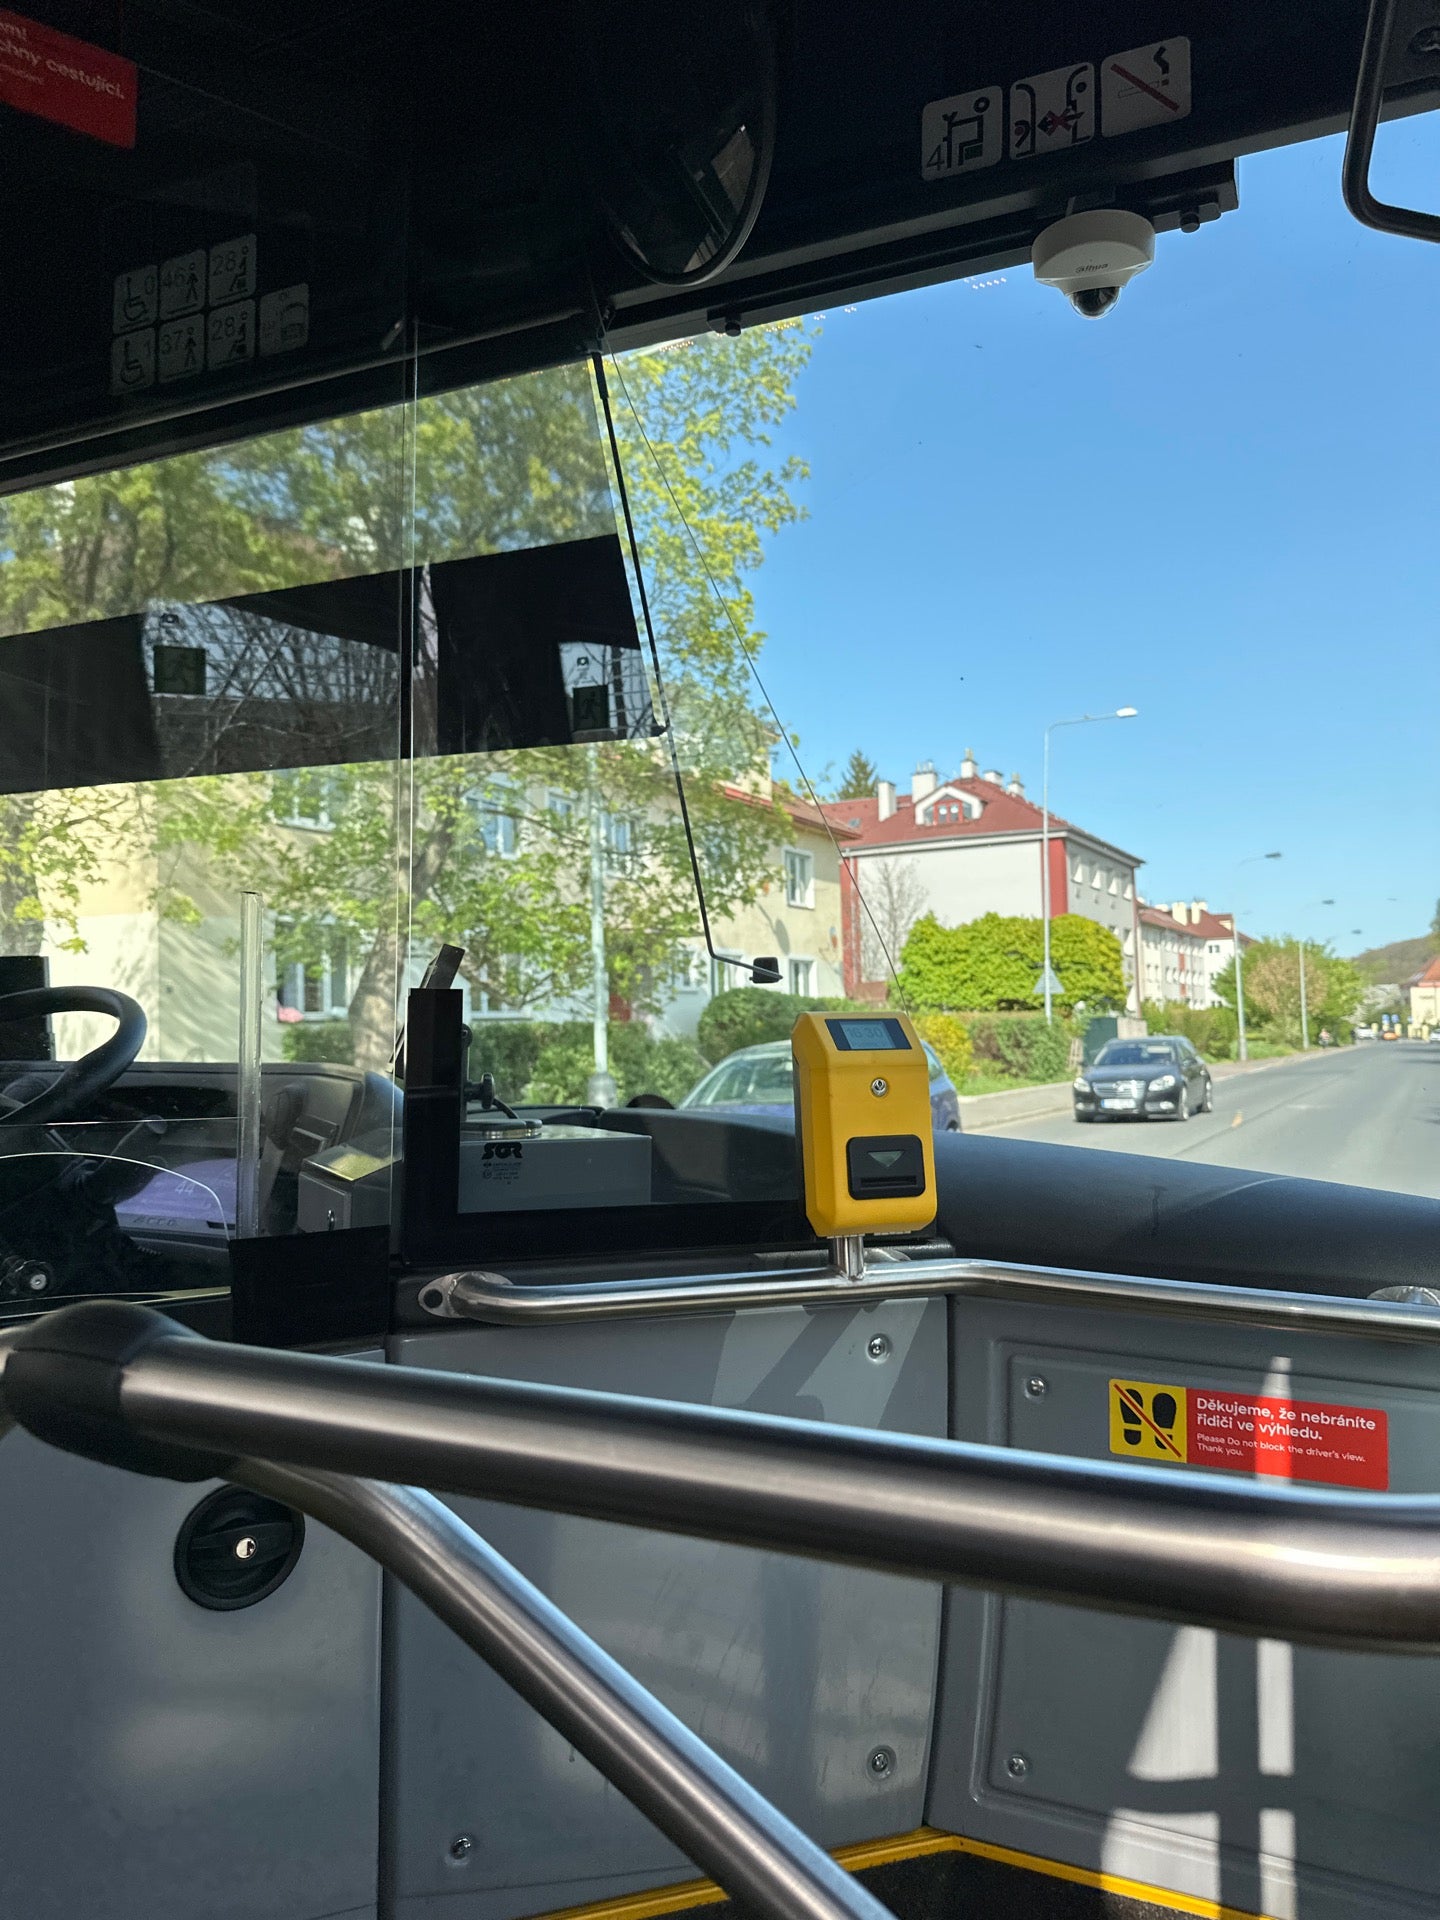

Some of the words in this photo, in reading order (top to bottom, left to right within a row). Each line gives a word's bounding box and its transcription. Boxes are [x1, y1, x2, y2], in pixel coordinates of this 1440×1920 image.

[926, 144, 944, 171] 4
[211, 250, 236, 276] 28
[211, 316, 236, 342] 28
[482, 1142, 523, 1160] SOR
[1197, 1397, 1275, 1420] Děkujeme,
[1279, 1406, 1296, 1421] že
[1301, 1411, 1376, 1430] nebráníte
[1197, 1413, 1233, 1429] řidiči
[1237, 1420, 1254, 1431] ve
[1259, 1422, 1323, 1440] výhledu.
[1197, 1433, 1225, 1444] Please
[1228, 1437, 1240, 1446] Do
[1242, 1439, 1258, 1448] not
[1259, 1441, 1285, 1452] block
[1288, 1445, 1303, 1454] the
[1306, 1447, 1339, 1459] driver's
[1341, 1452, 1366, 1462] view.
[1197, 1442, 1224, 1453] Thank
[1225, 1446, 1243, 1457] you.
